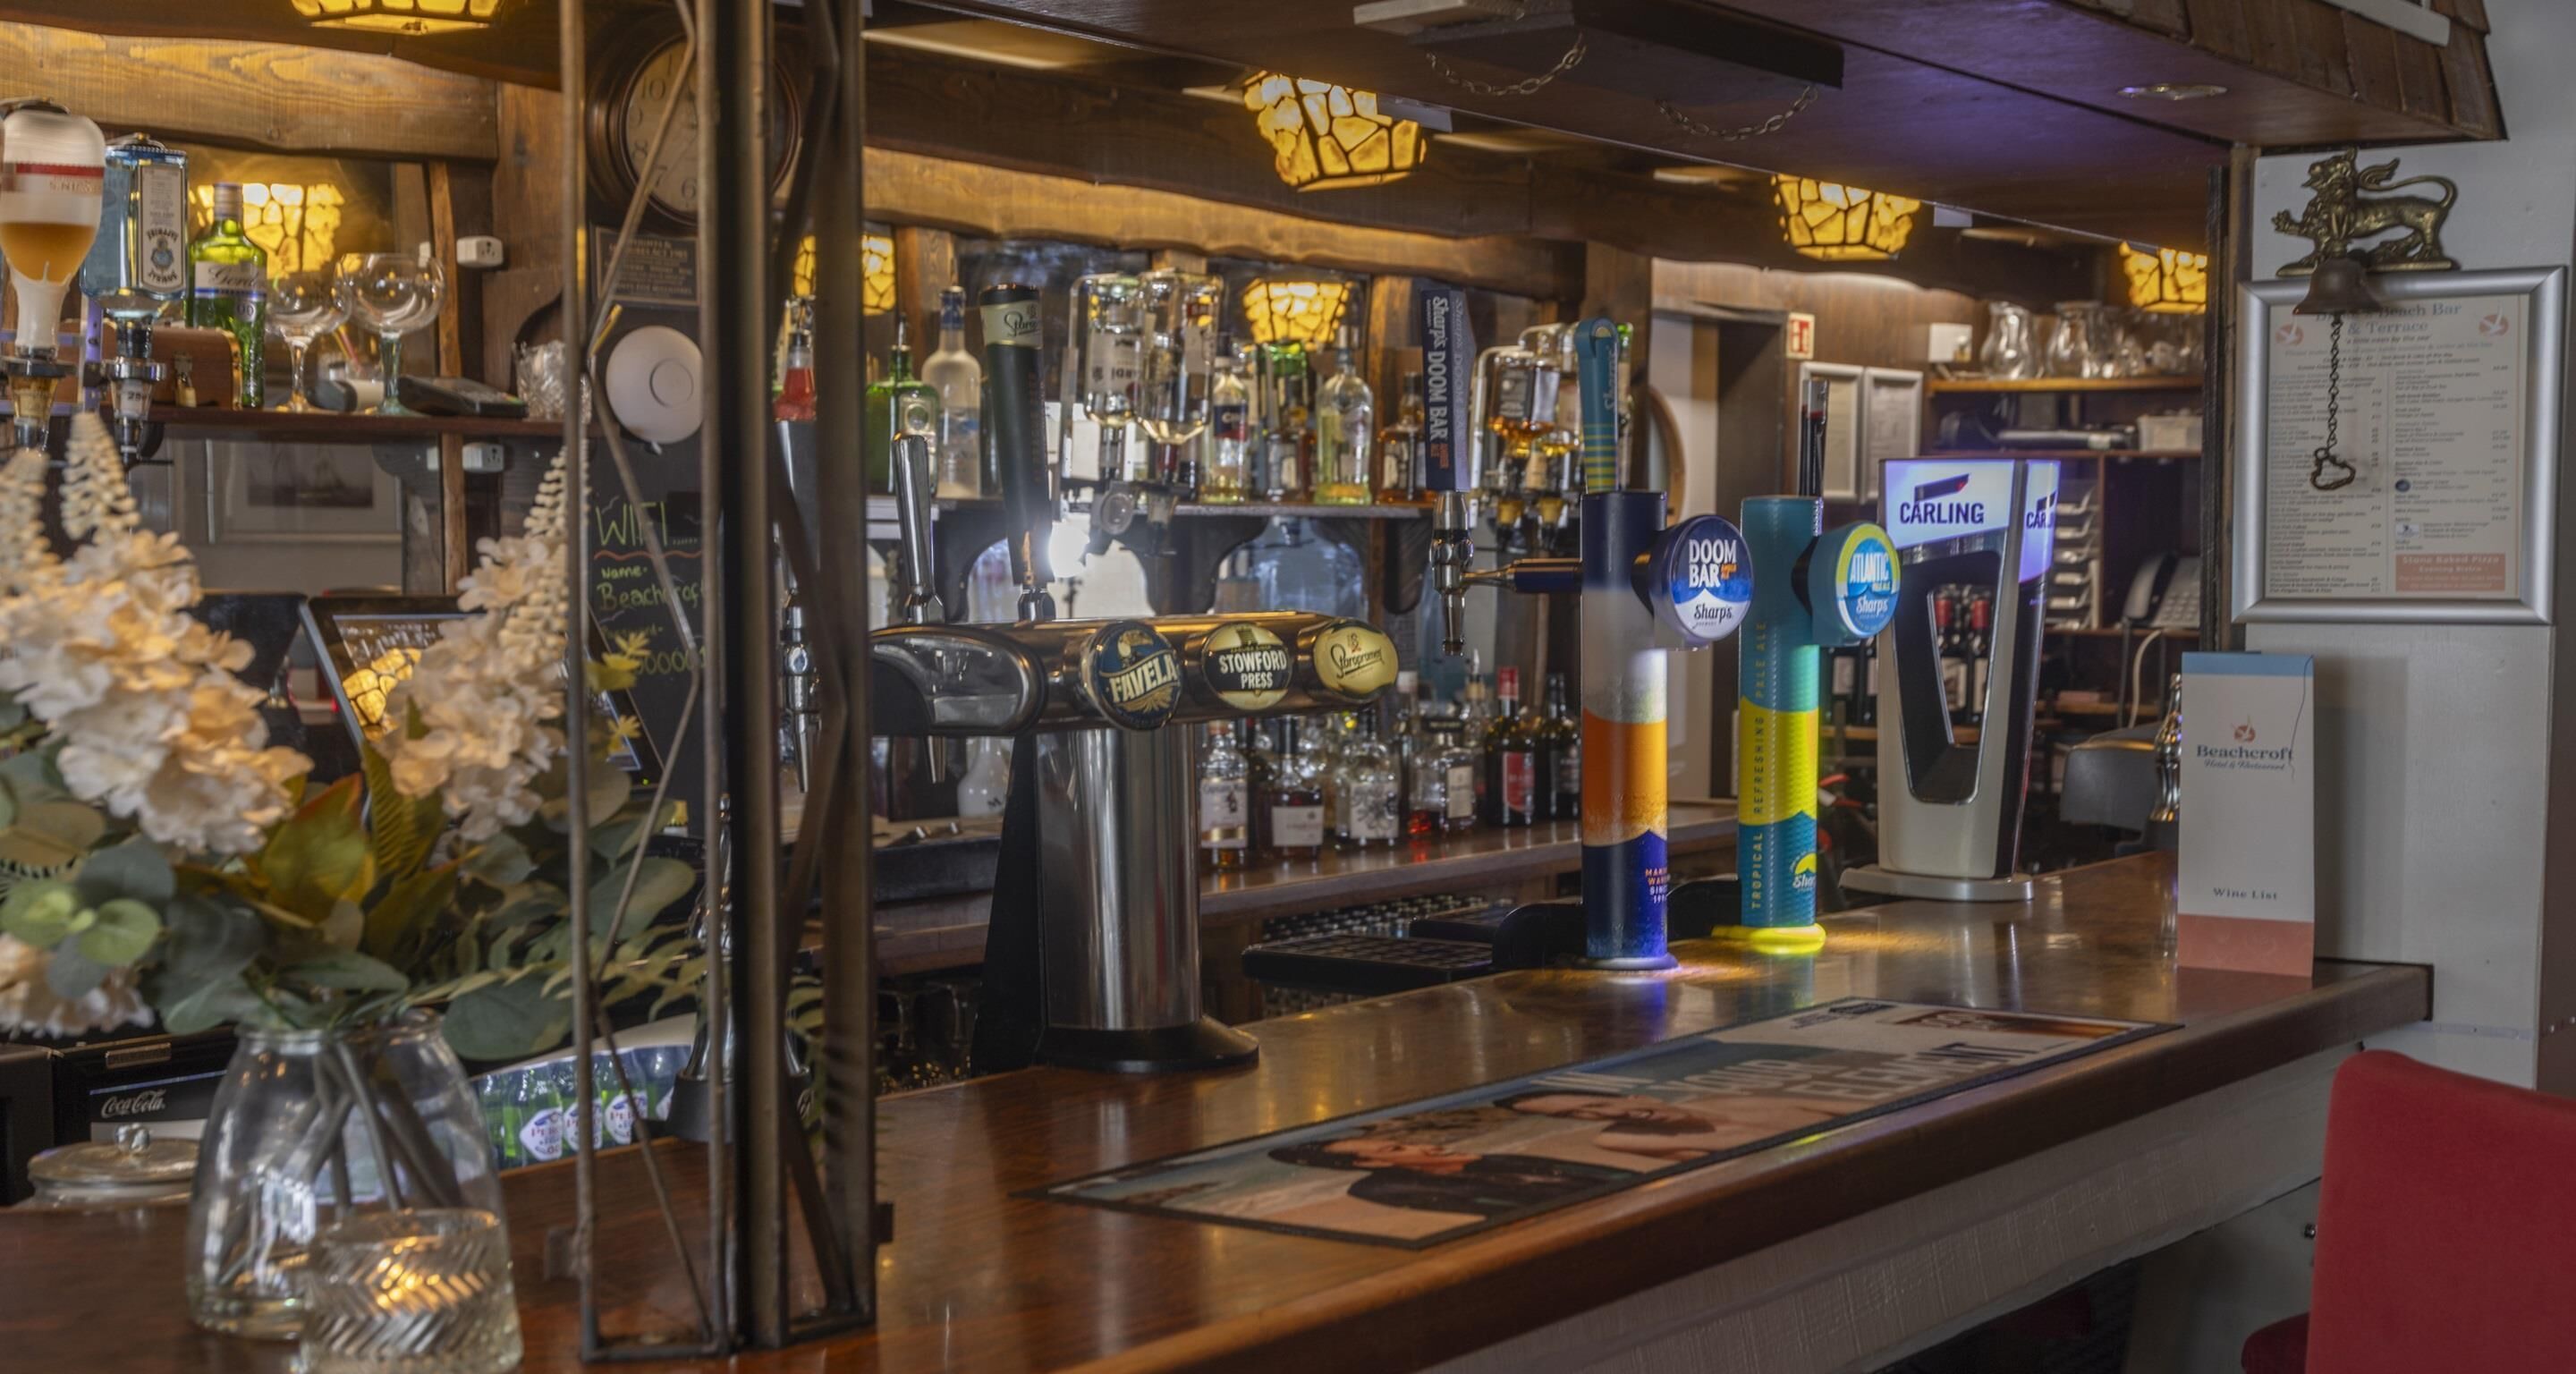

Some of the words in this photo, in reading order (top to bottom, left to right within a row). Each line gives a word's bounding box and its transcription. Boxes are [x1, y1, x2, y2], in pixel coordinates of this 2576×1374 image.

[1428, 296, 1450, 348] Sharp's
[2432, 302, 2462, 316] Bar
[1428, 351, 1448, 402] DOOM
[1430, 405, 1449, 441] BAR
[1899, 502, 1986, 525] CARLING
[1688, 539, 1738, 565] DOOM
[1688, 564, 1722, 589] BAR
[1849, 551, 1890, 584] ATLANTIC
[1218, 649, 1288, 674] STOWFORD
[1108, 652, 1180, 704] FAVELA
[1240, 671, 1274, 691] PRESS
[1755, 659, 1767, 700] PALE
[1752, 717, 1766, 815] REFRESHING
[2196, 743, 2292, 760] Beachcroft
[1750, 832, 1764, 911] TROPICAL
[2213, 886, 2248, 899] Wine
[2251, 889, 2278, 901] List
